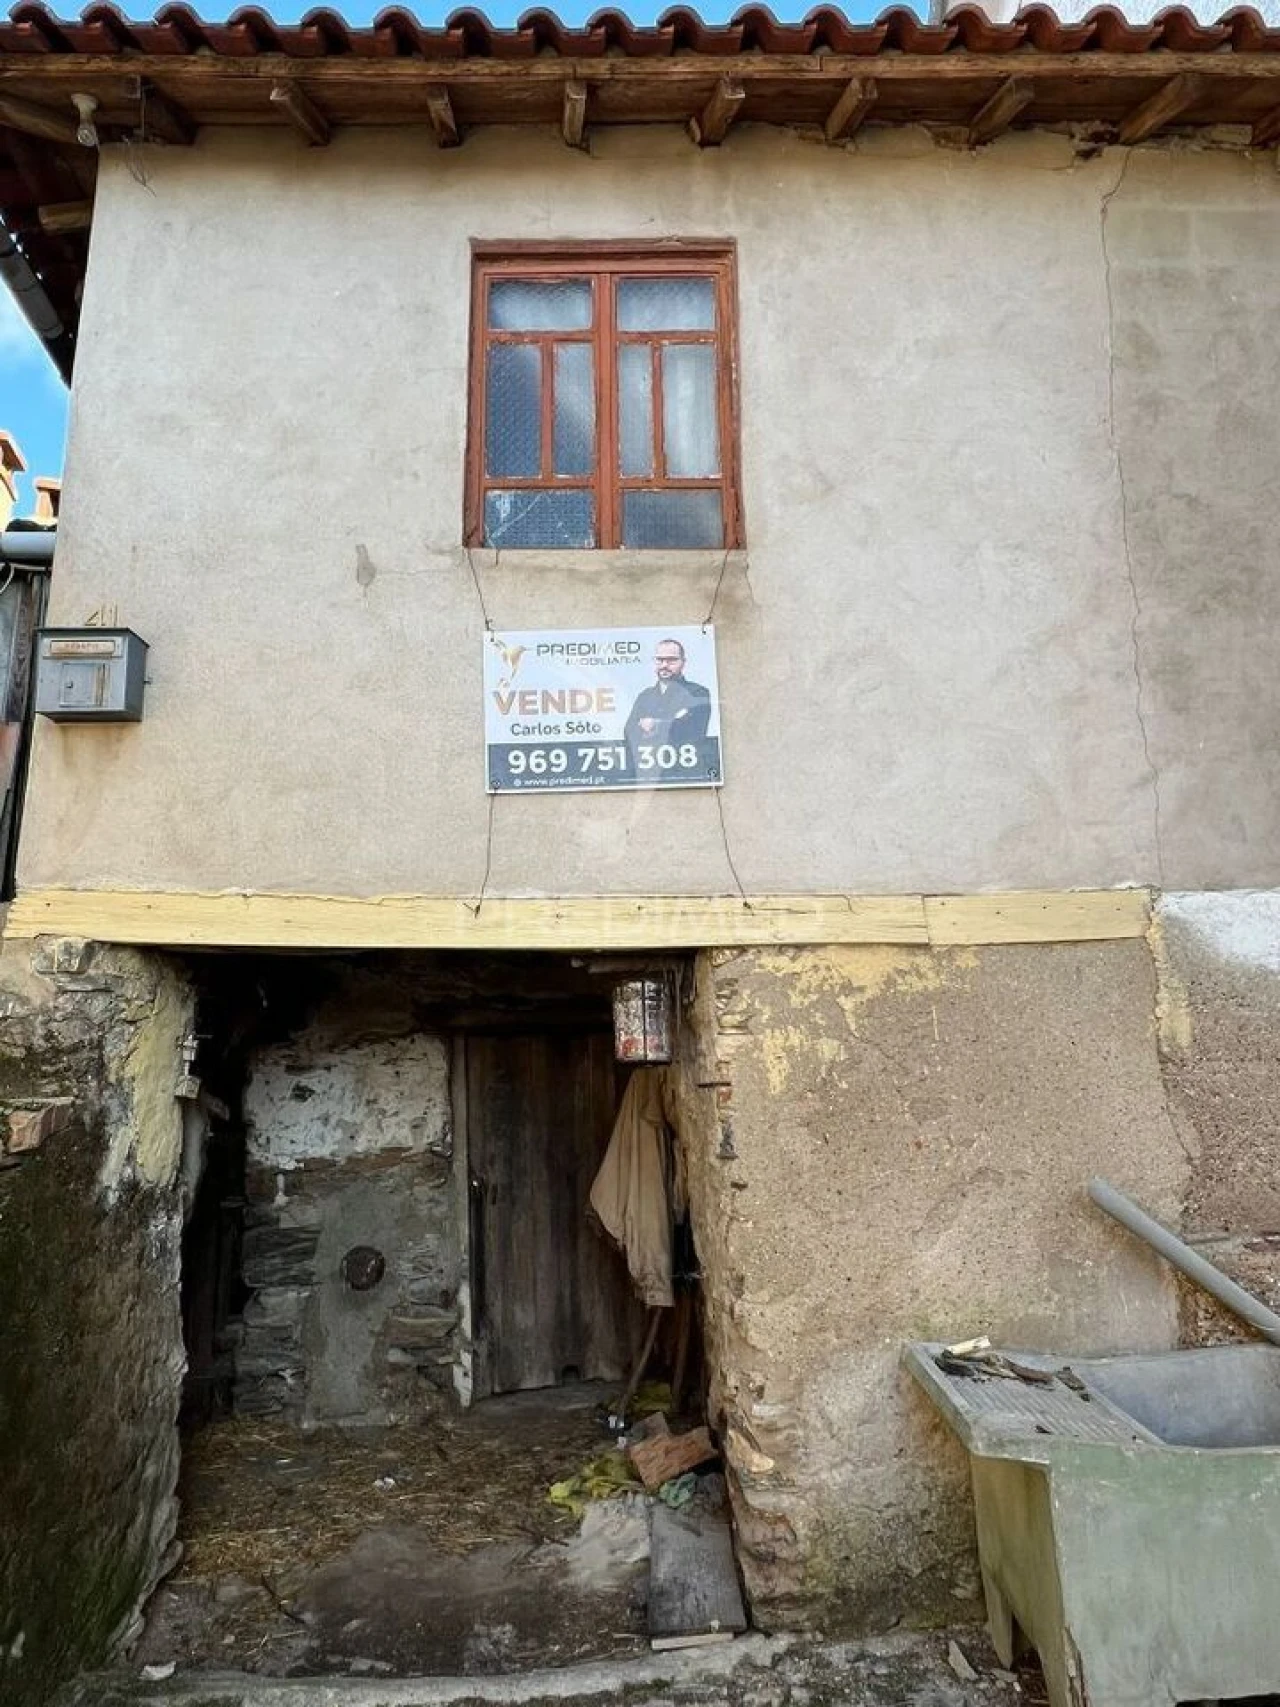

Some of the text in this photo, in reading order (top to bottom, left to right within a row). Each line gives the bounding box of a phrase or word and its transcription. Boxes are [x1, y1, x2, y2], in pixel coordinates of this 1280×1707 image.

[536, 641, 641, 657] PREDIMED
[492, 688, 616, 716] VENDE
[510, 722, 561, 737] Carlos
[508, 744, 698, 774] 969 751 308
[524, 775, 605, 787] www.predimed.pt
